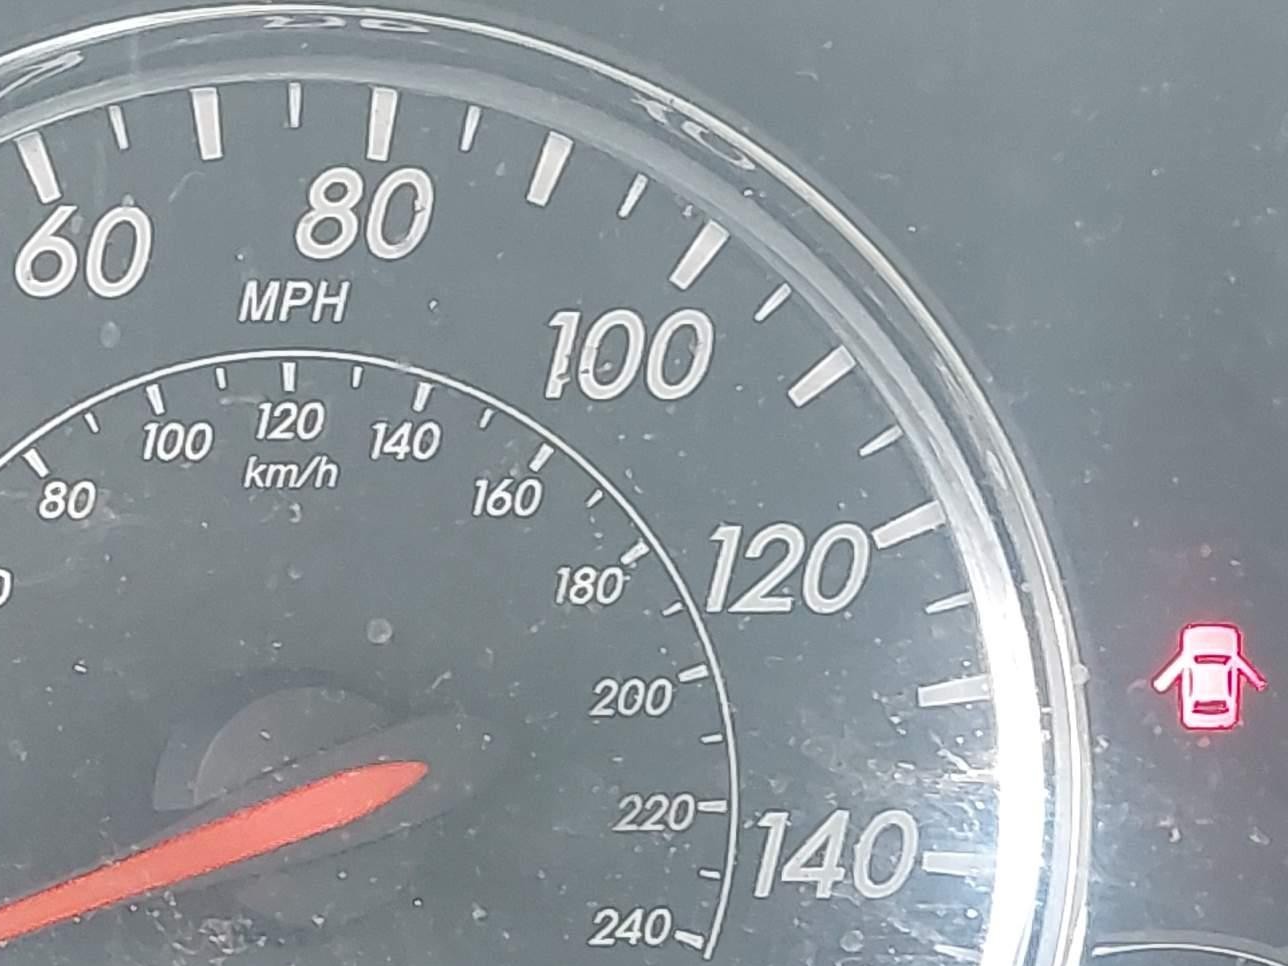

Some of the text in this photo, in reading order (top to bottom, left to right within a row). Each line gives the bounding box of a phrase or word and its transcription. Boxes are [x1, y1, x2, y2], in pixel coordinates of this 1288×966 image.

[296, 167, 435, 260] 80
[15, 205, 152, 298] 60
[238, 279, 351, 324] MPH
[544, 308, 715, 401] 100
[255, 399, 325, 442] 120
[140, 422, 213, 463] 100
[369, 422, 443, 464] 140
[242, 455, 340, 490] km/h
[38, 479, 96, 521] 80
[472, 477, 542, 518] 160
[555, 566, 625, 606] 180
[707, 523, 871, 615] 120
[589, 677, 674, 719] 200
[611, 793, 696, 834] 220
[753, 809, 918, 900] 140
[587, 907, 672, 948] 240
